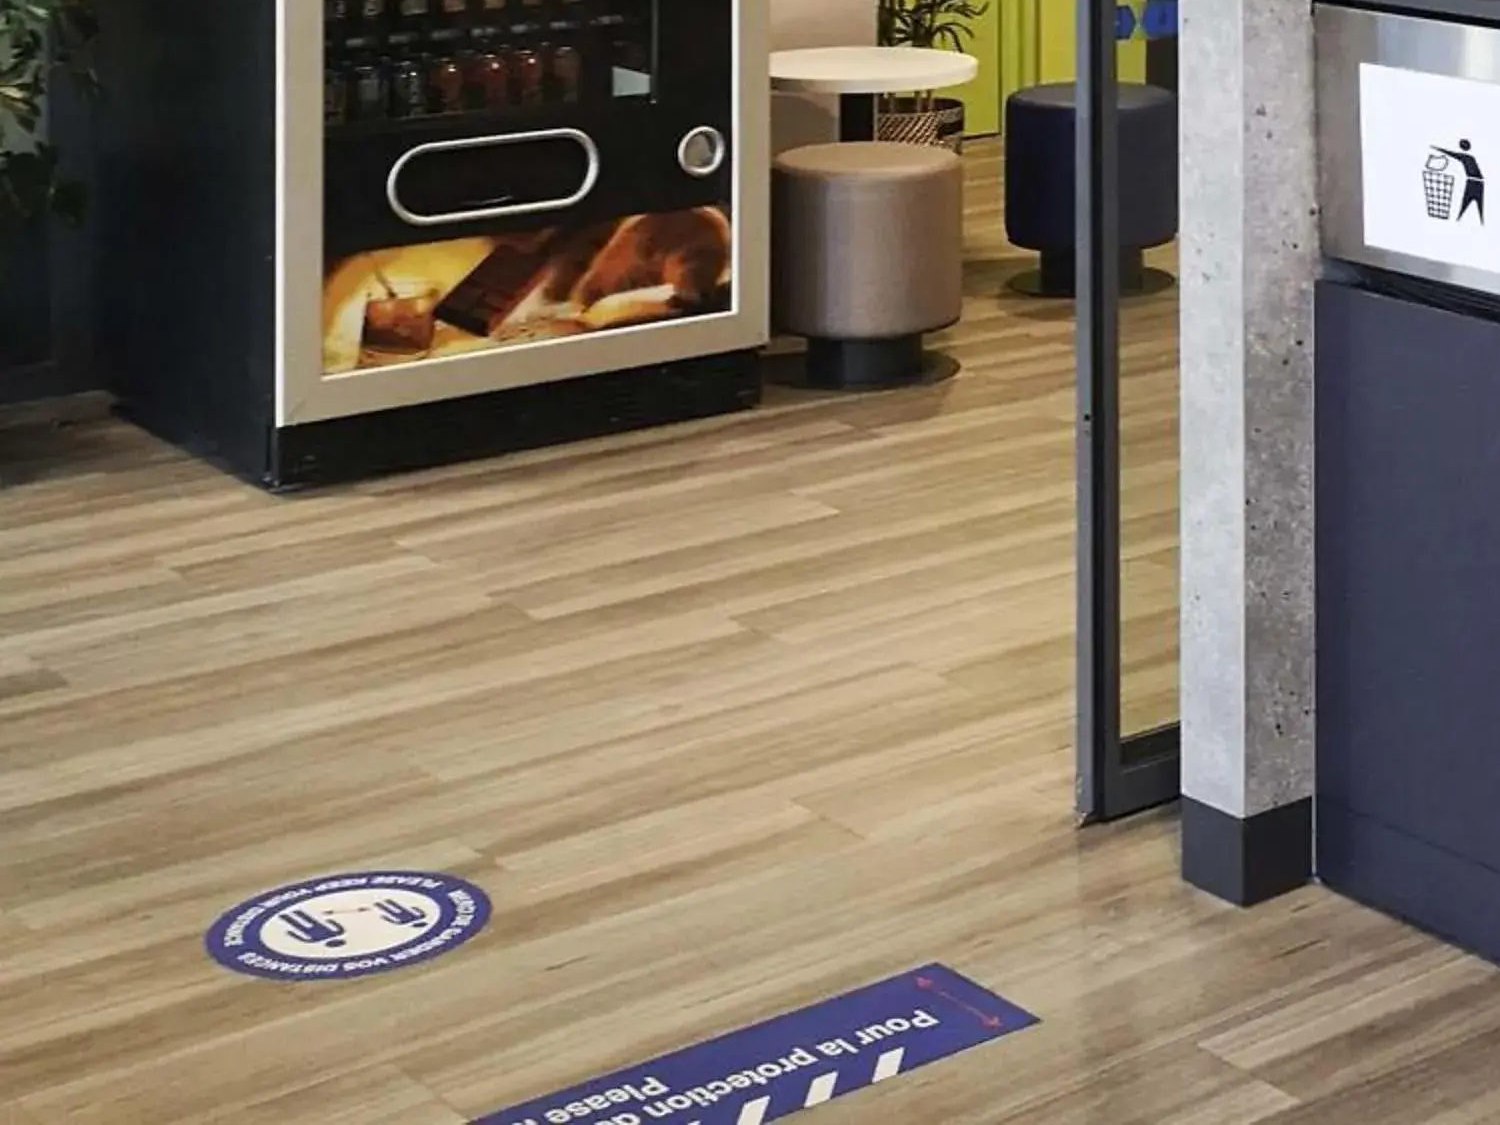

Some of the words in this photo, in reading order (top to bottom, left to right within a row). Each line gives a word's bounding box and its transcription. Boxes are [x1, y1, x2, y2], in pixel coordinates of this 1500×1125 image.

[342, 957, 390, 972] VOS
[855, 1008, 942, 1046] Pour
[815, 1037, 860, 1057] la
[543, 1076, 671, 1124] Please
[642, 1047, 820, 1118] protection
